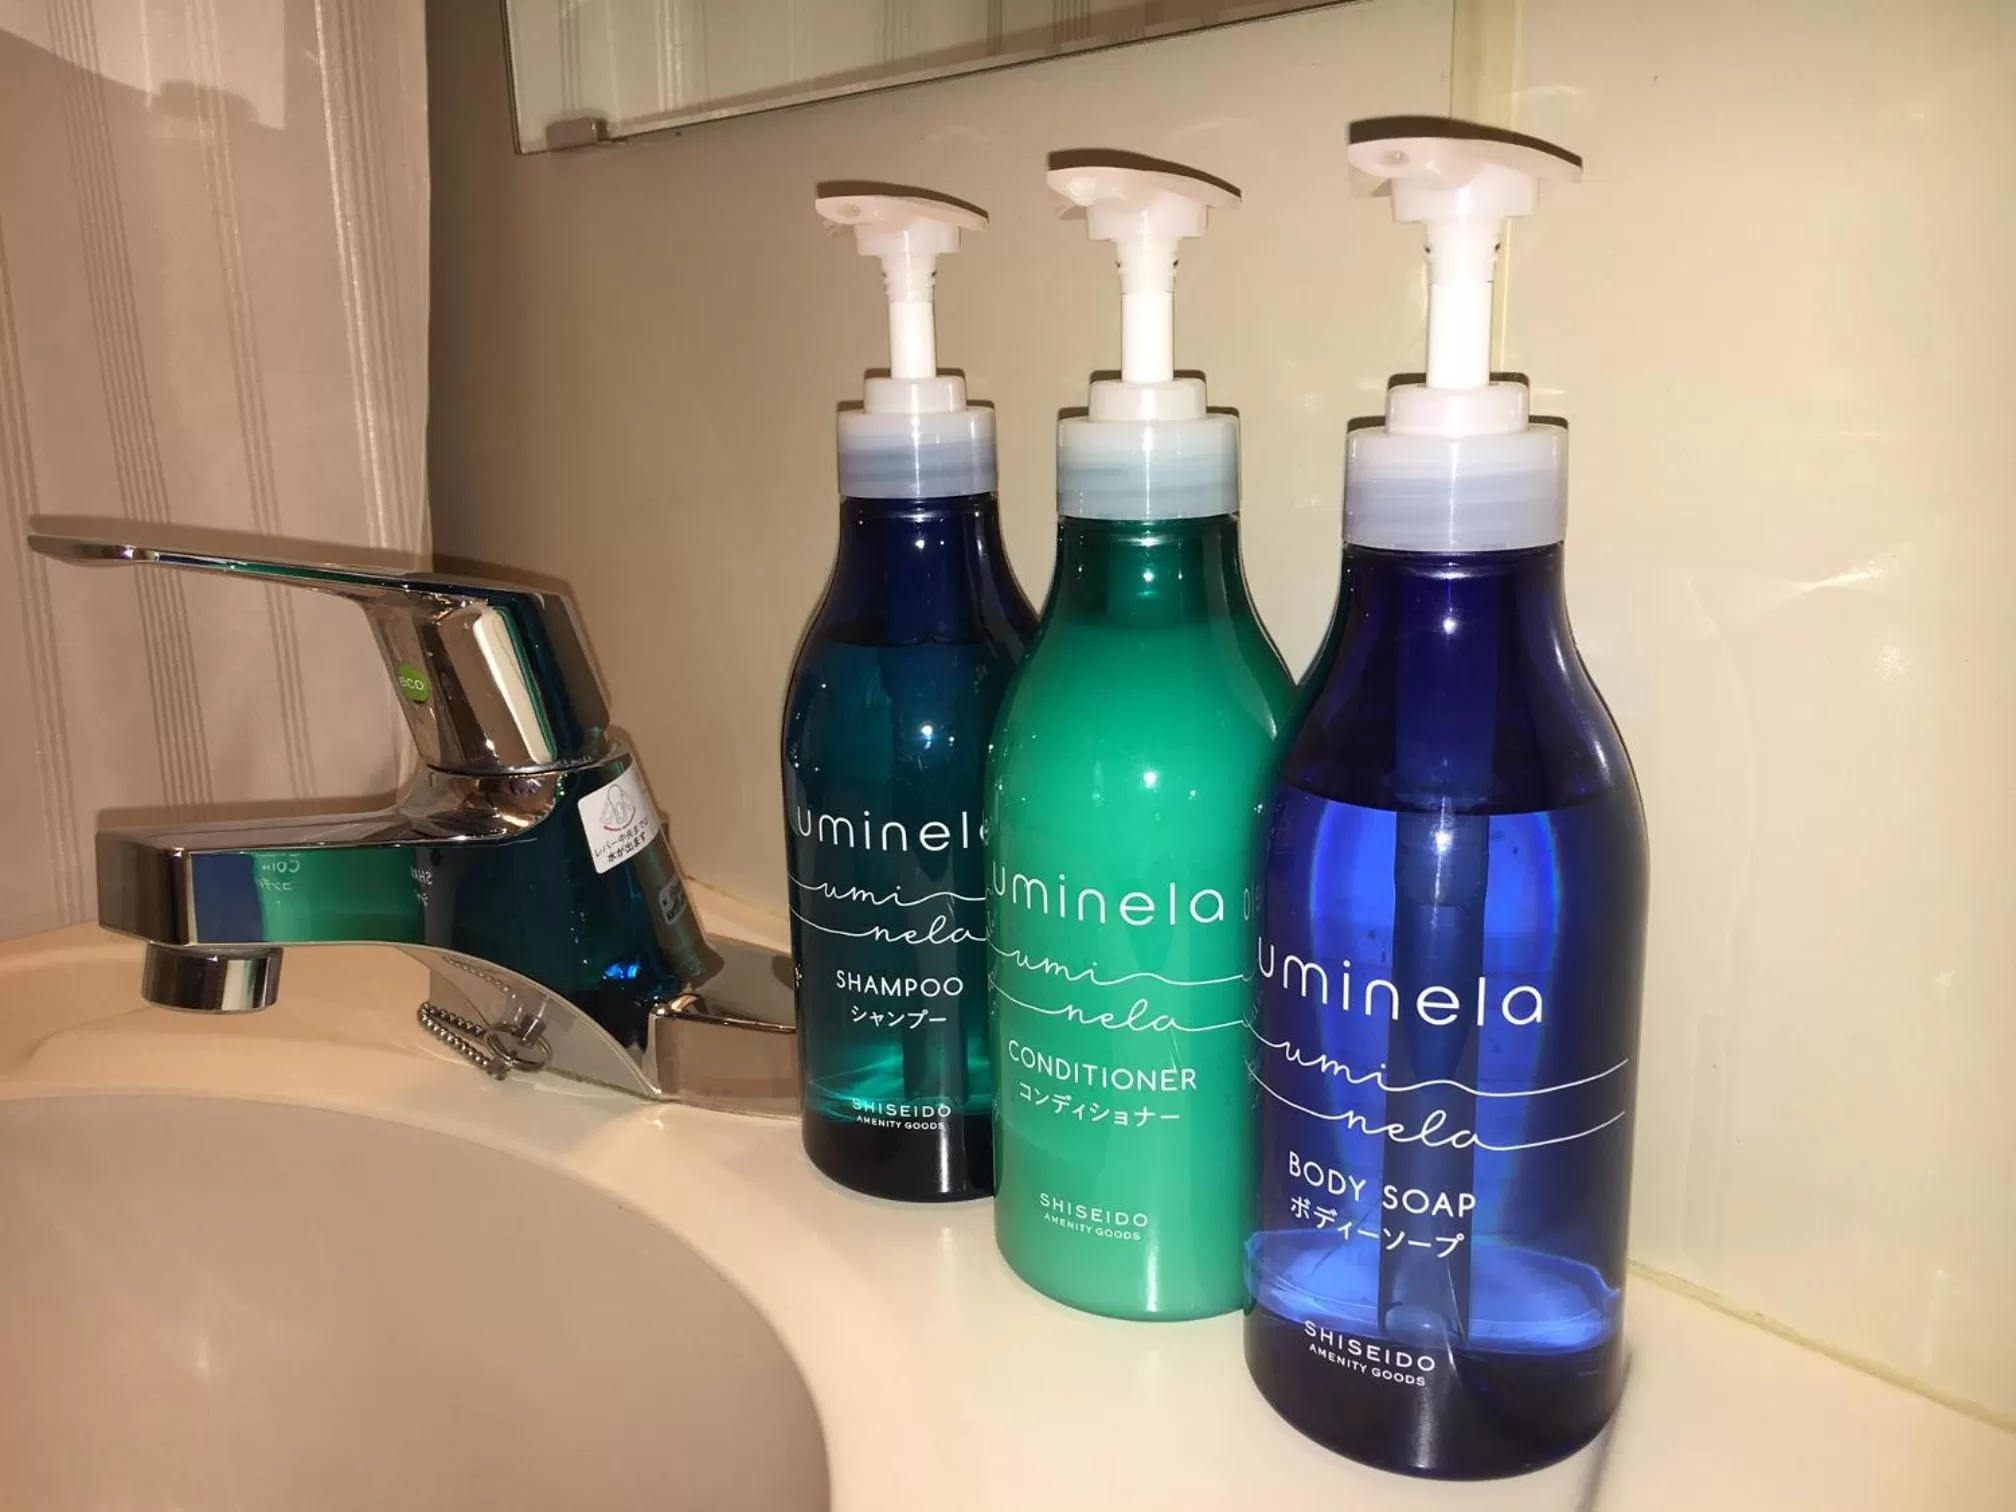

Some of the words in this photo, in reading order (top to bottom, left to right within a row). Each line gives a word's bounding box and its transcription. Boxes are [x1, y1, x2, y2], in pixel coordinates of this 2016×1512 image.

[607, 831, 647, 863] 水が出ます
[797, 805, 988, 852] uminel
[992, 860, 1225, 926] uminela
[869, 914, 980, 945] nela
[836, 969, 964, 998] SHAMPOO
[1257, 935, 1543, 1027] uminela
[850, 1004, 948, 1030] シャンプー
[1060, 998, 1182, 1032] nela
[1007, 1039, 1198, 1092] CONDITIONER
[852, 1097, 951, 1119] SHISEIDO
[856, 1115, 901, 1130] AMENITY
[904, 1121, 946, 1131] GOODS
[1018, 1081, 1181, 1128] コンディショナー
[1338, 1109, 1486, 1148] nela
[1288, 1150, 1367, 1202] BODY
[1381, 1184, 1477, 1218] SOAP
[1039, 1192, 1149, 1228] SHISEIDO
[1043, 1212, 1093, 1235] AMENITY
[1095, 1227, 1142, 1241] GOODS
[1290, 1196, 1465, 1258] ボディーソープ
[1303, 1319, 1436, 1372] SHISEIDO
[1308, 1343, 1368, 1375] AMENITY
[1371, 1366, 1426, 1387] GOODS
